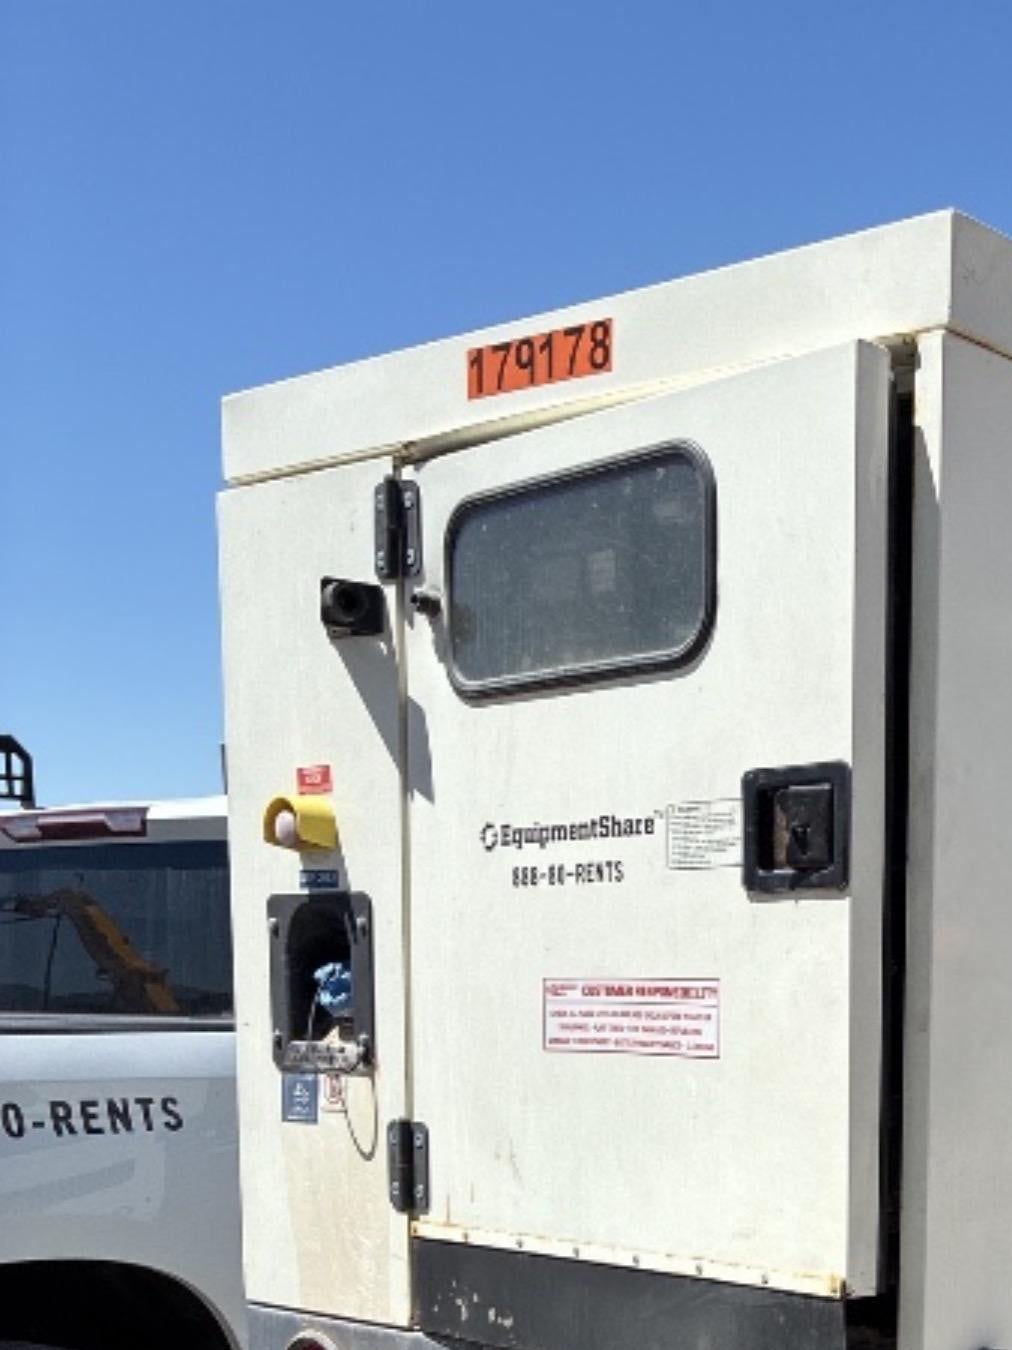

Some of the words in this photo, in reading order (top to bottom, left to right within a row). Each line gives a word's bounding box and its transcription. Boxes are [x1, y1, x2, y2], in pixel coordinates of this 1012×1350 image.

[469, 320, 610, 394] 179178
[500, 815, 654, 849] EquipmentShare
[512, 861, 624, 888] 888-80-RENTS
